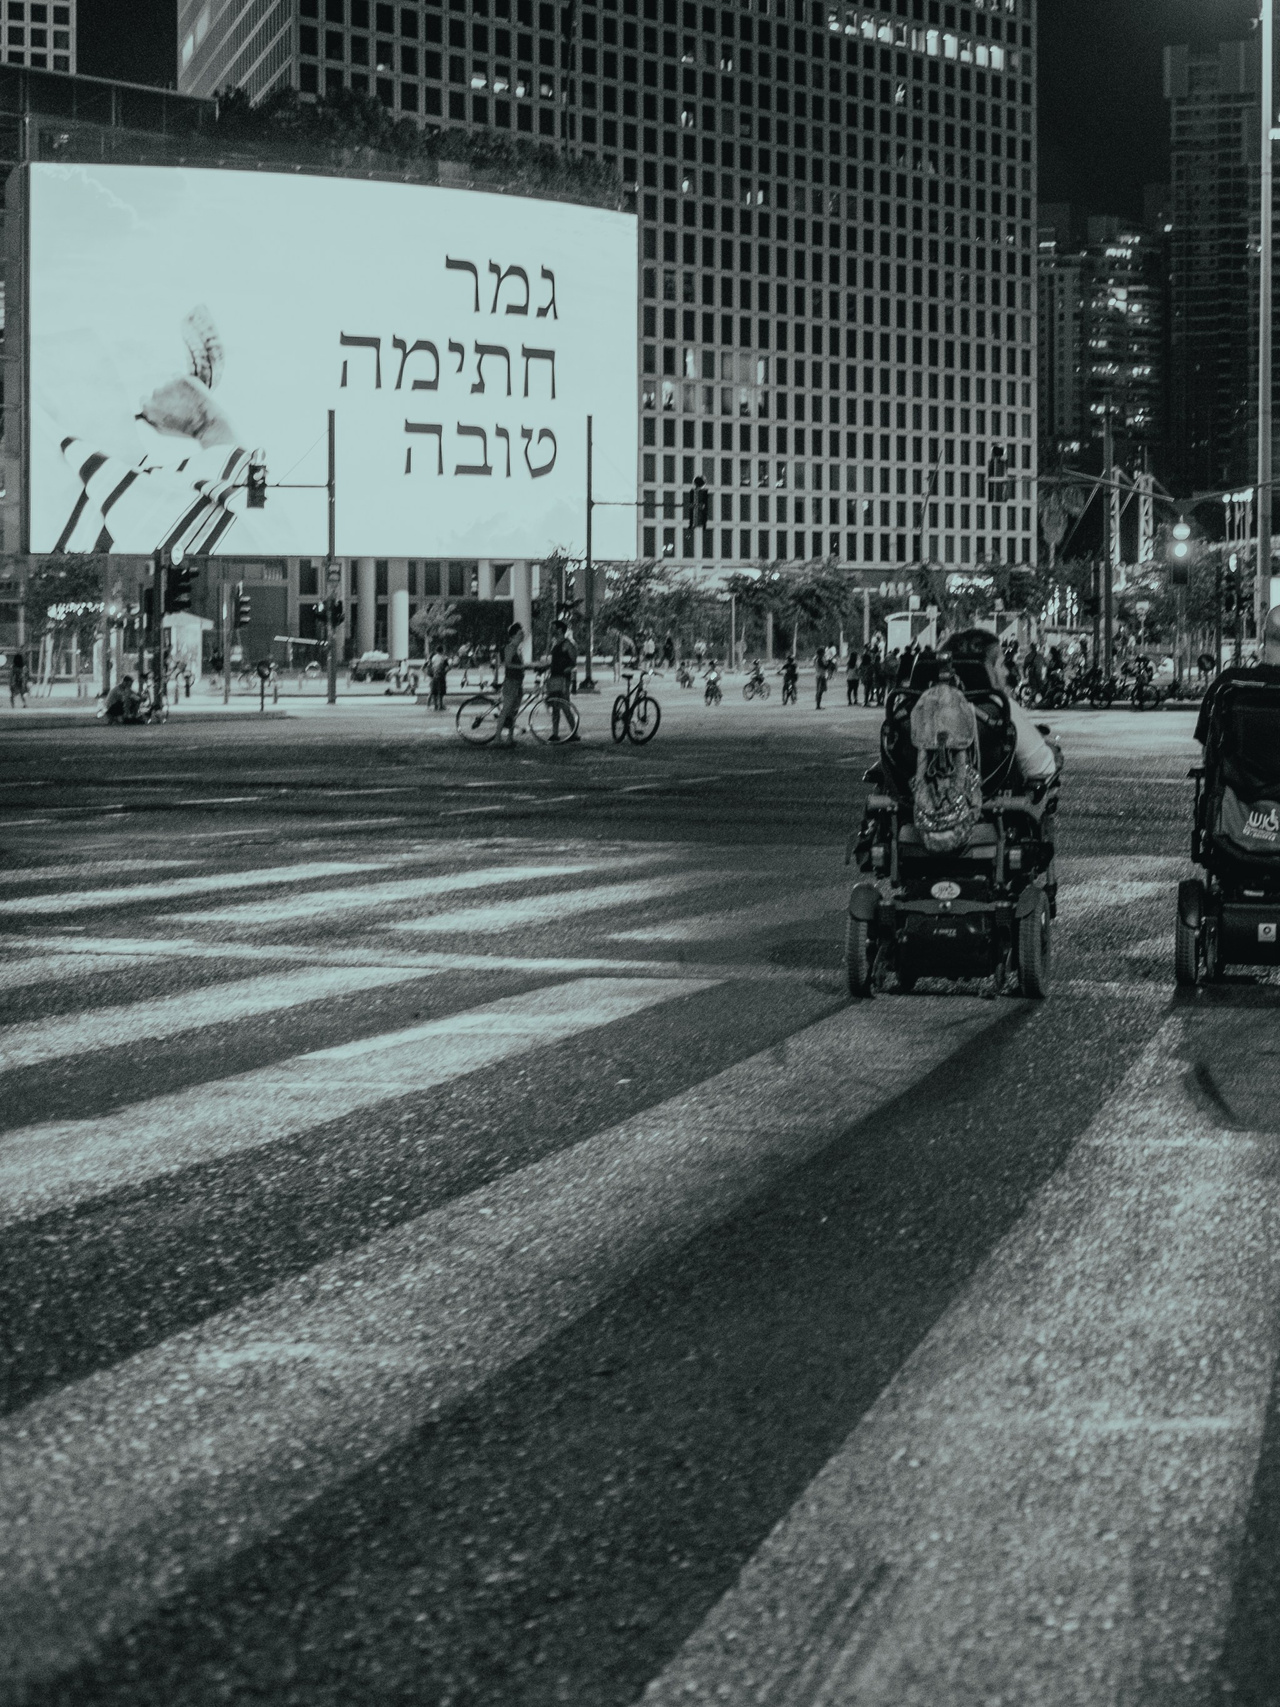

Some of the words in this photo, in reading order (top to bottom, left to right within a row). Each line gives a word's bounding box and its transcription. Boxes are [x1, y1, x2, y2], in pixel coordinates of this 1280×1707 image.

[446, 254, 558, 319] גמר
[340, 331, 556, 399] חתימה
[404, 418, 557, 478] טובה
